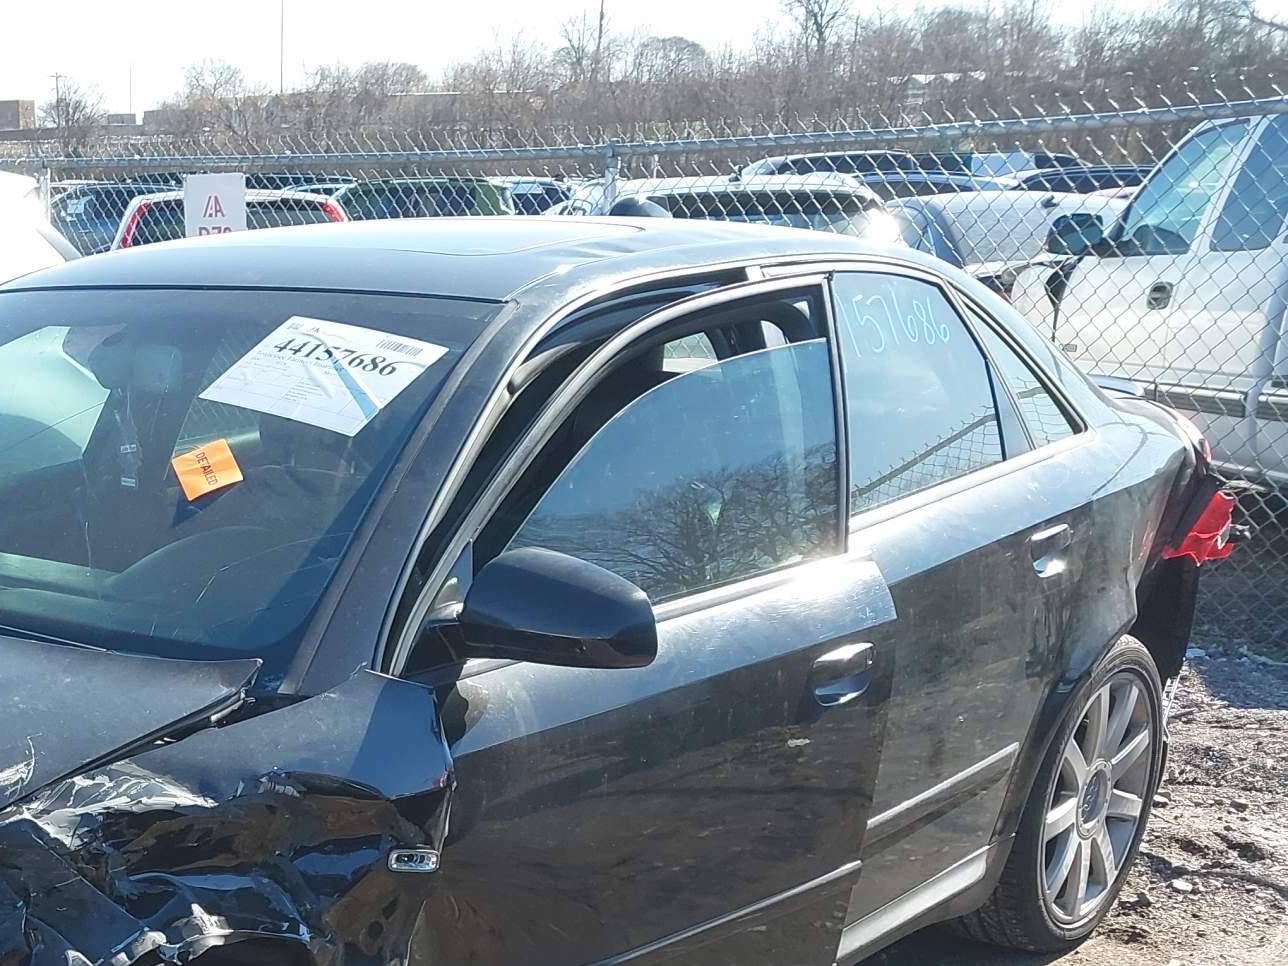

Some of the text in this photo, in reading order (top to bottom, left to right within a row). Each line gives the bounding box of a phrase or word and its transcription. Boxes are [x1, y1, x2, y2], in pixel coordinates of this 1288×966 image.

[833, 283, 950, 358] 157686
[273, 337, 398, 378] 44157686
[195, 452, 219, 487] DETAILED
